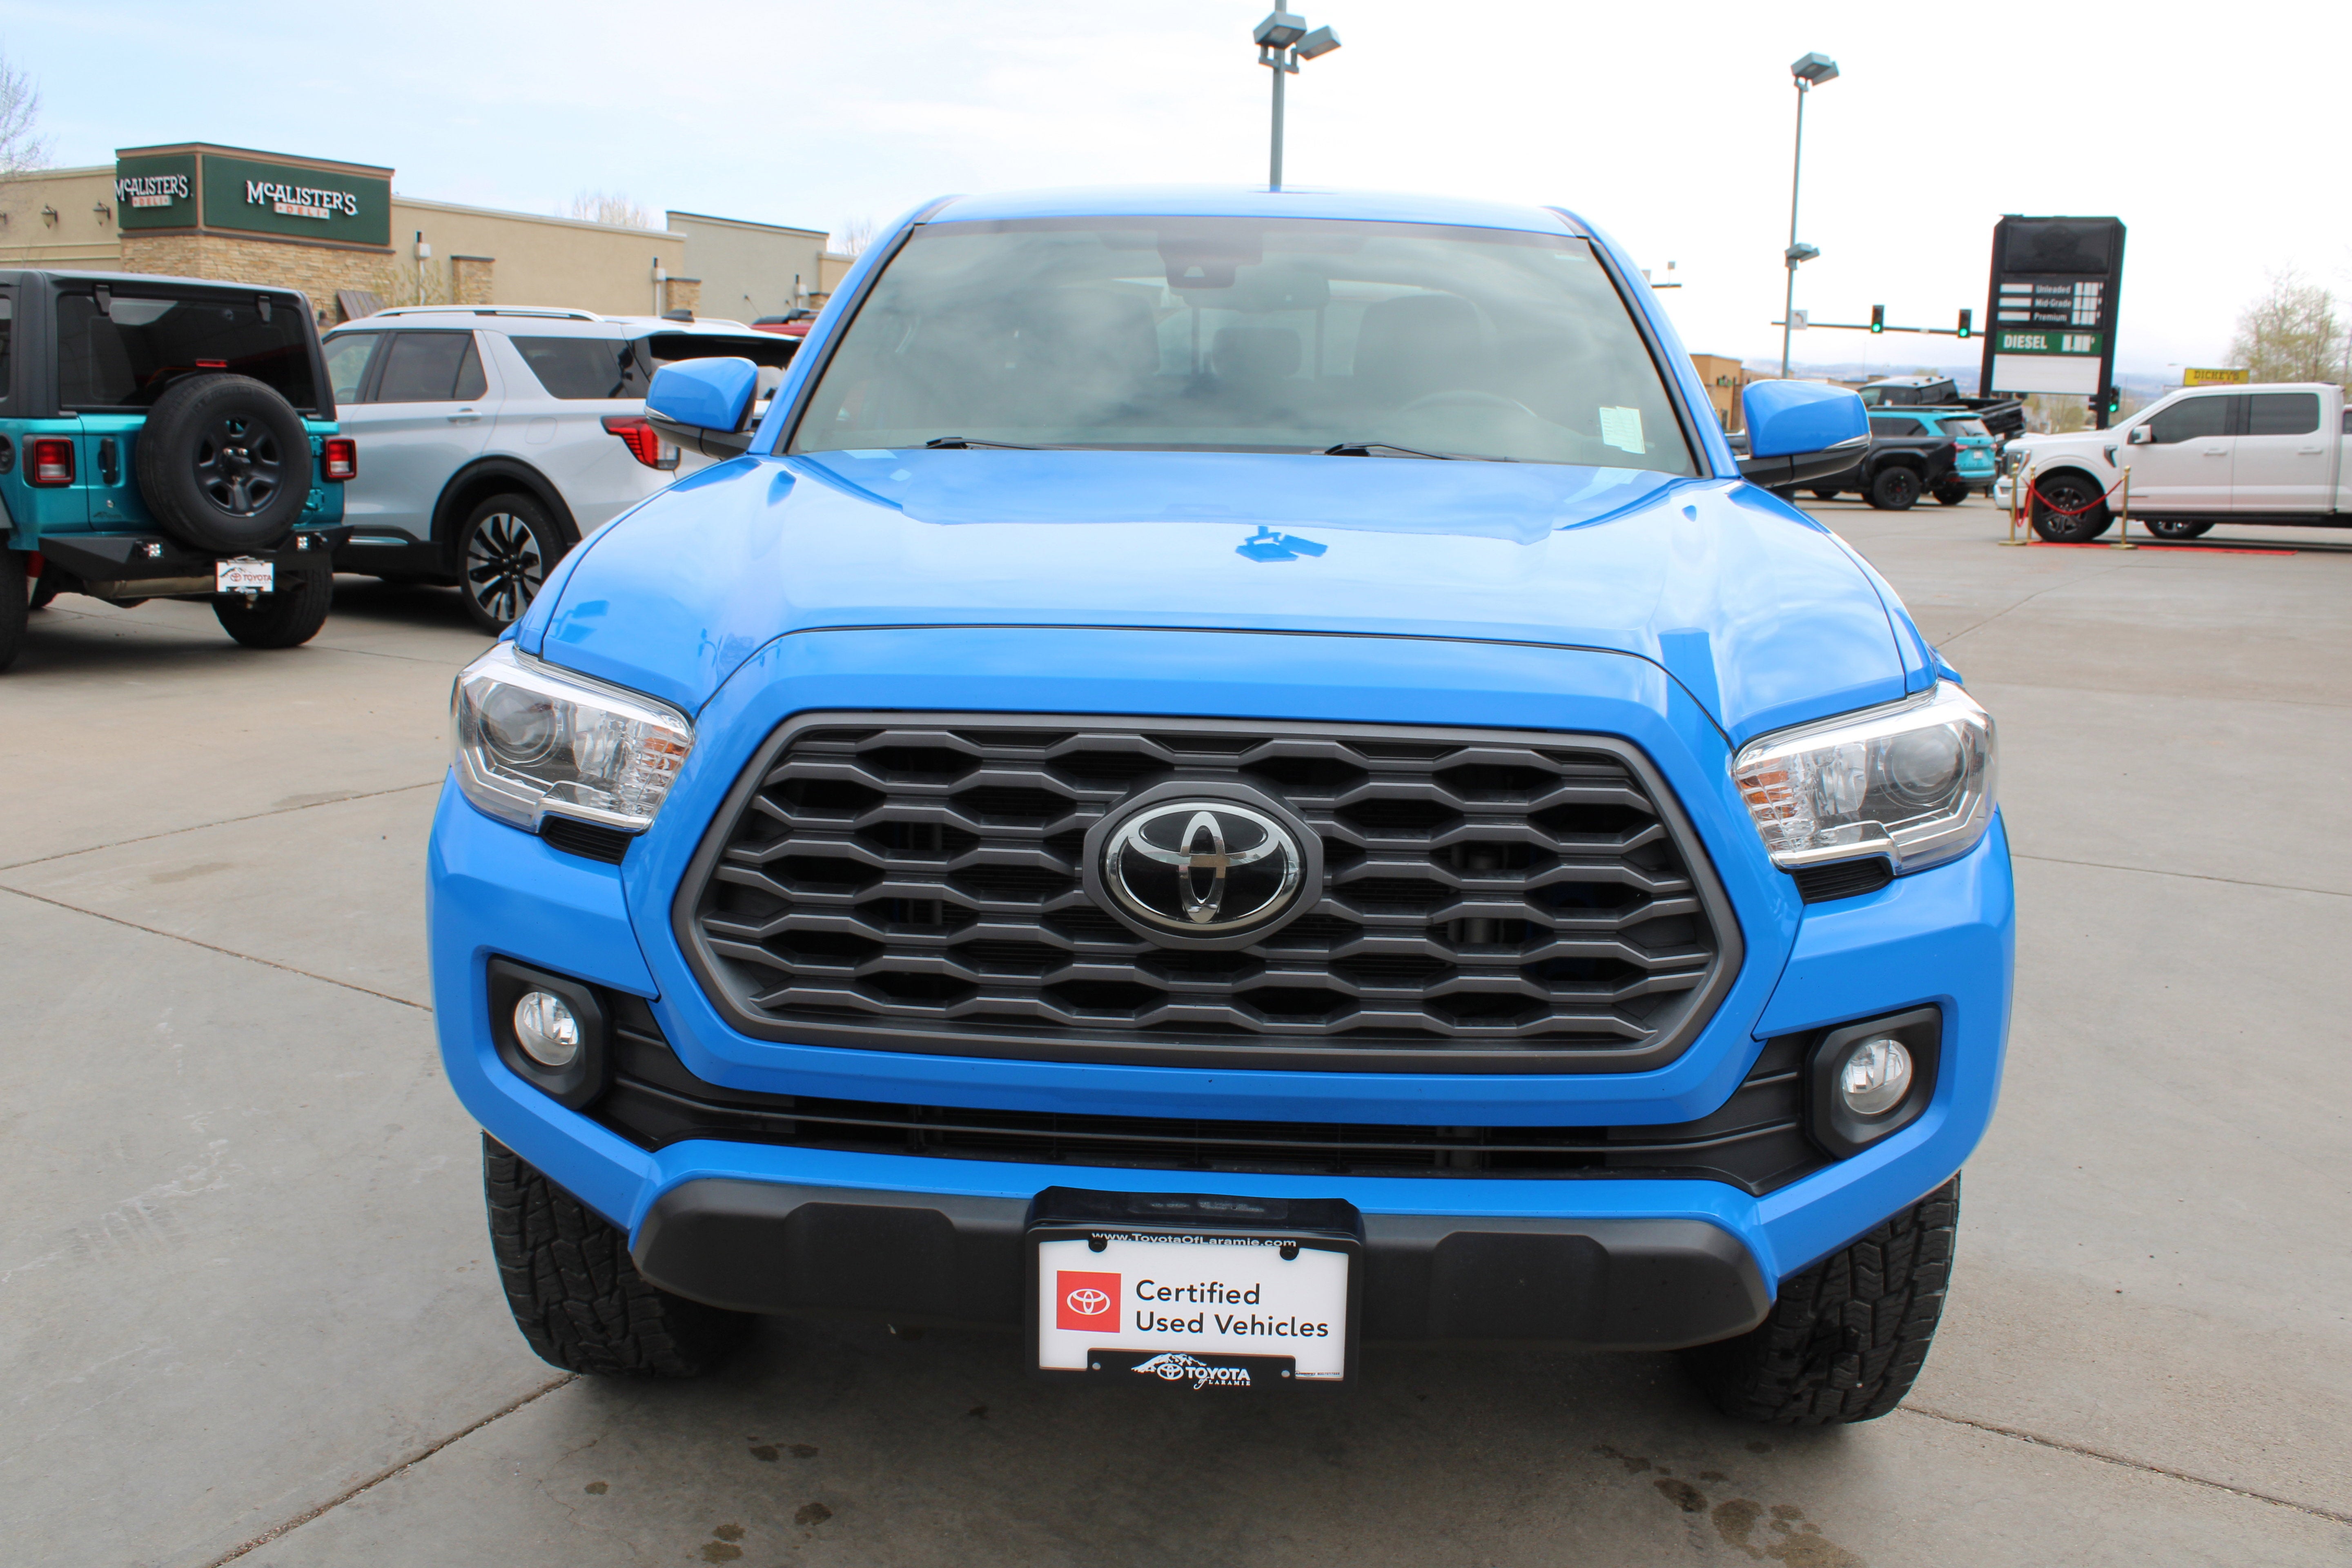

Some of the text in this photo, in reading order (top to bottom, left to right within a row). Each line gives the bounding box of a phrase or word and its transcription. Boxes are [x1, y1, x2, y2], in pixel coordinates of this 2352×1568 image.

[287, 206, 321, 216] DELI
[2036, 285, 2071, 294] Unleaded
[2034, 298, 2072, 308] Mid-Grade
[2033, 312, 2067, 321] Premium
[2003, 334, 2048, 350] DIESEL
[1091, 1232, 1297, 1247] www.ToyotaOfLaramie.com
[1136, 1279, 1260, 1305] Certified
[1136, 1311, 1329, 1337] Used Vehicles
[1185, 1367, 1251, 1381] TOYOTA
[1193, 1376, 1209, 1390] of
